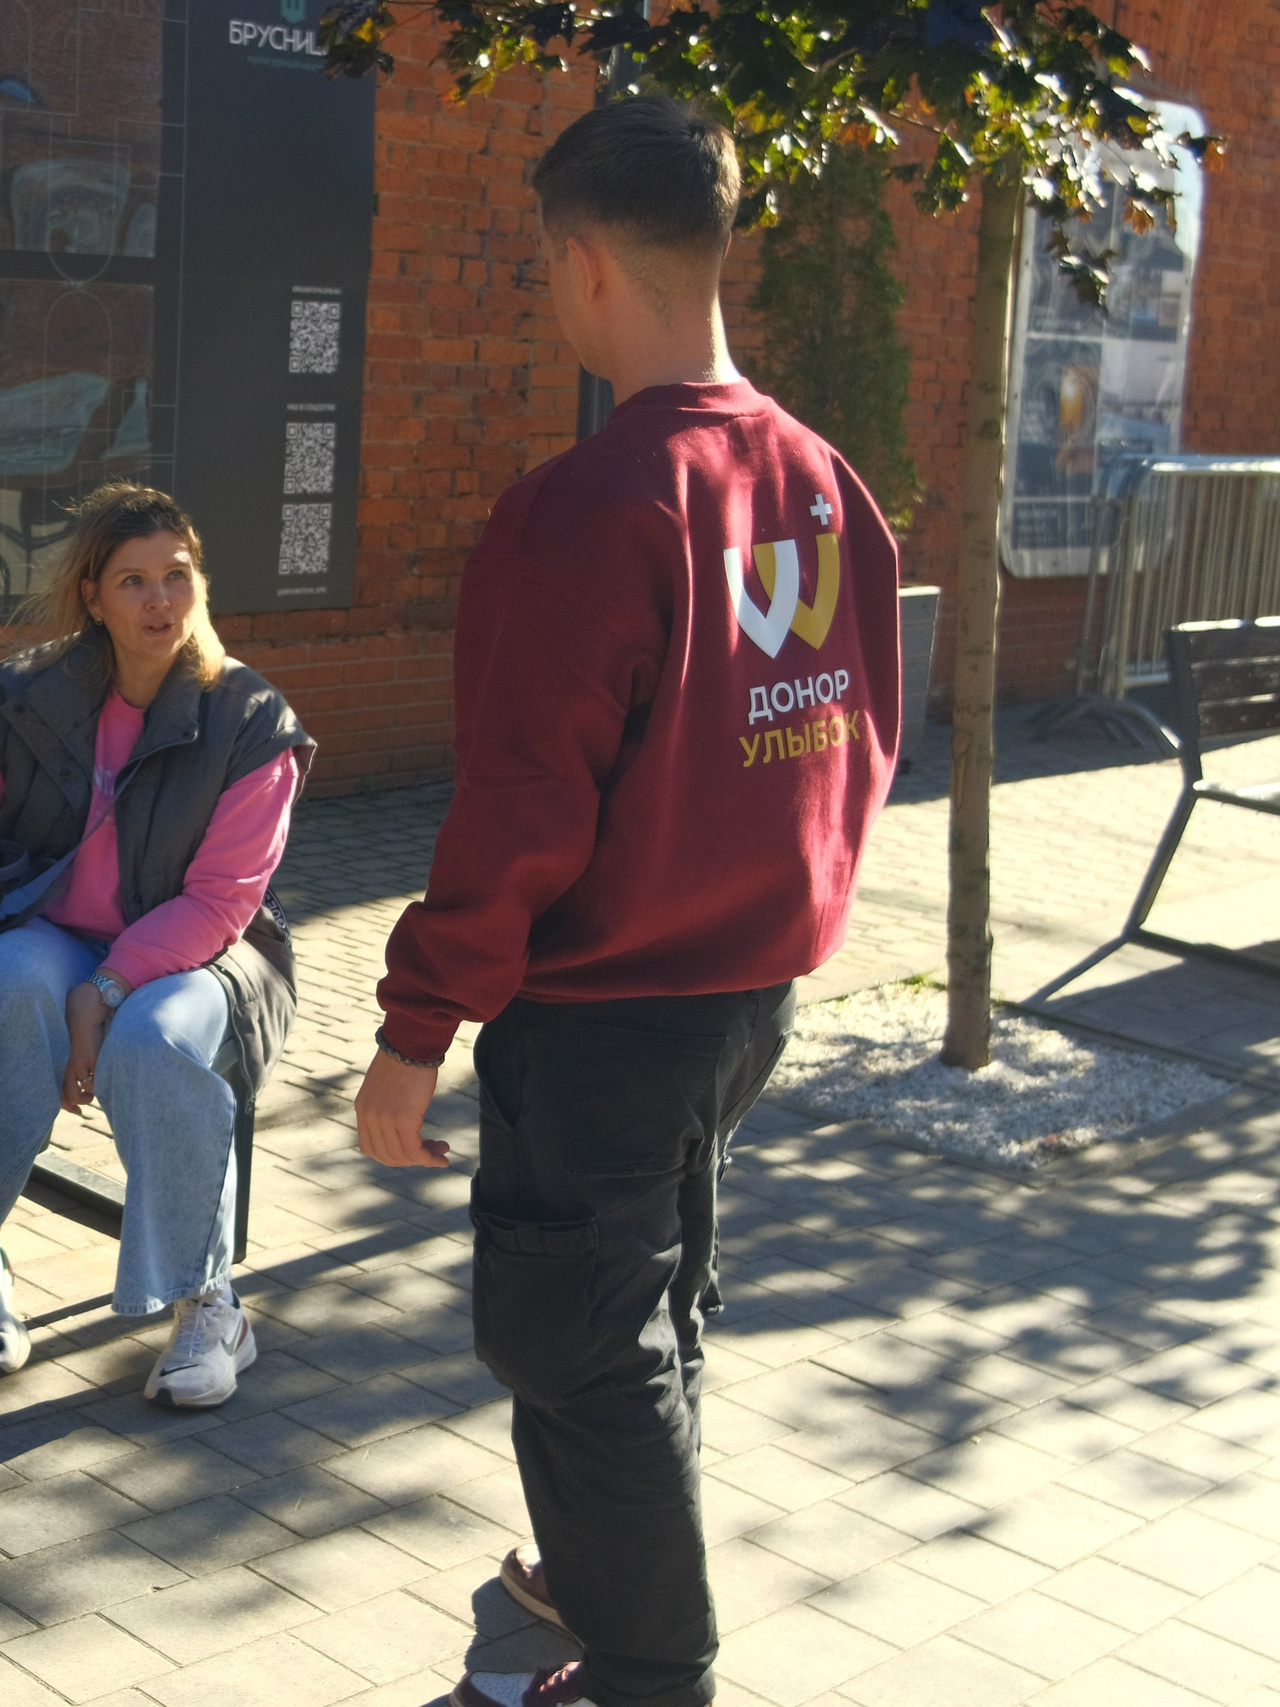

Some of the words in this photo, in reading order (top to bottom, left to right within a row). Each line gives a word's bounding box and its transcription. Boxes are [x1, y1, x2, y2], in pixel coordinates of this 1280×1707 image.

[229, 19, 328, 56] БРУСНИЦ
[747, 669, 850, 725] ДОНОР
[738, 710, 860, 768] УЛЫБОК
